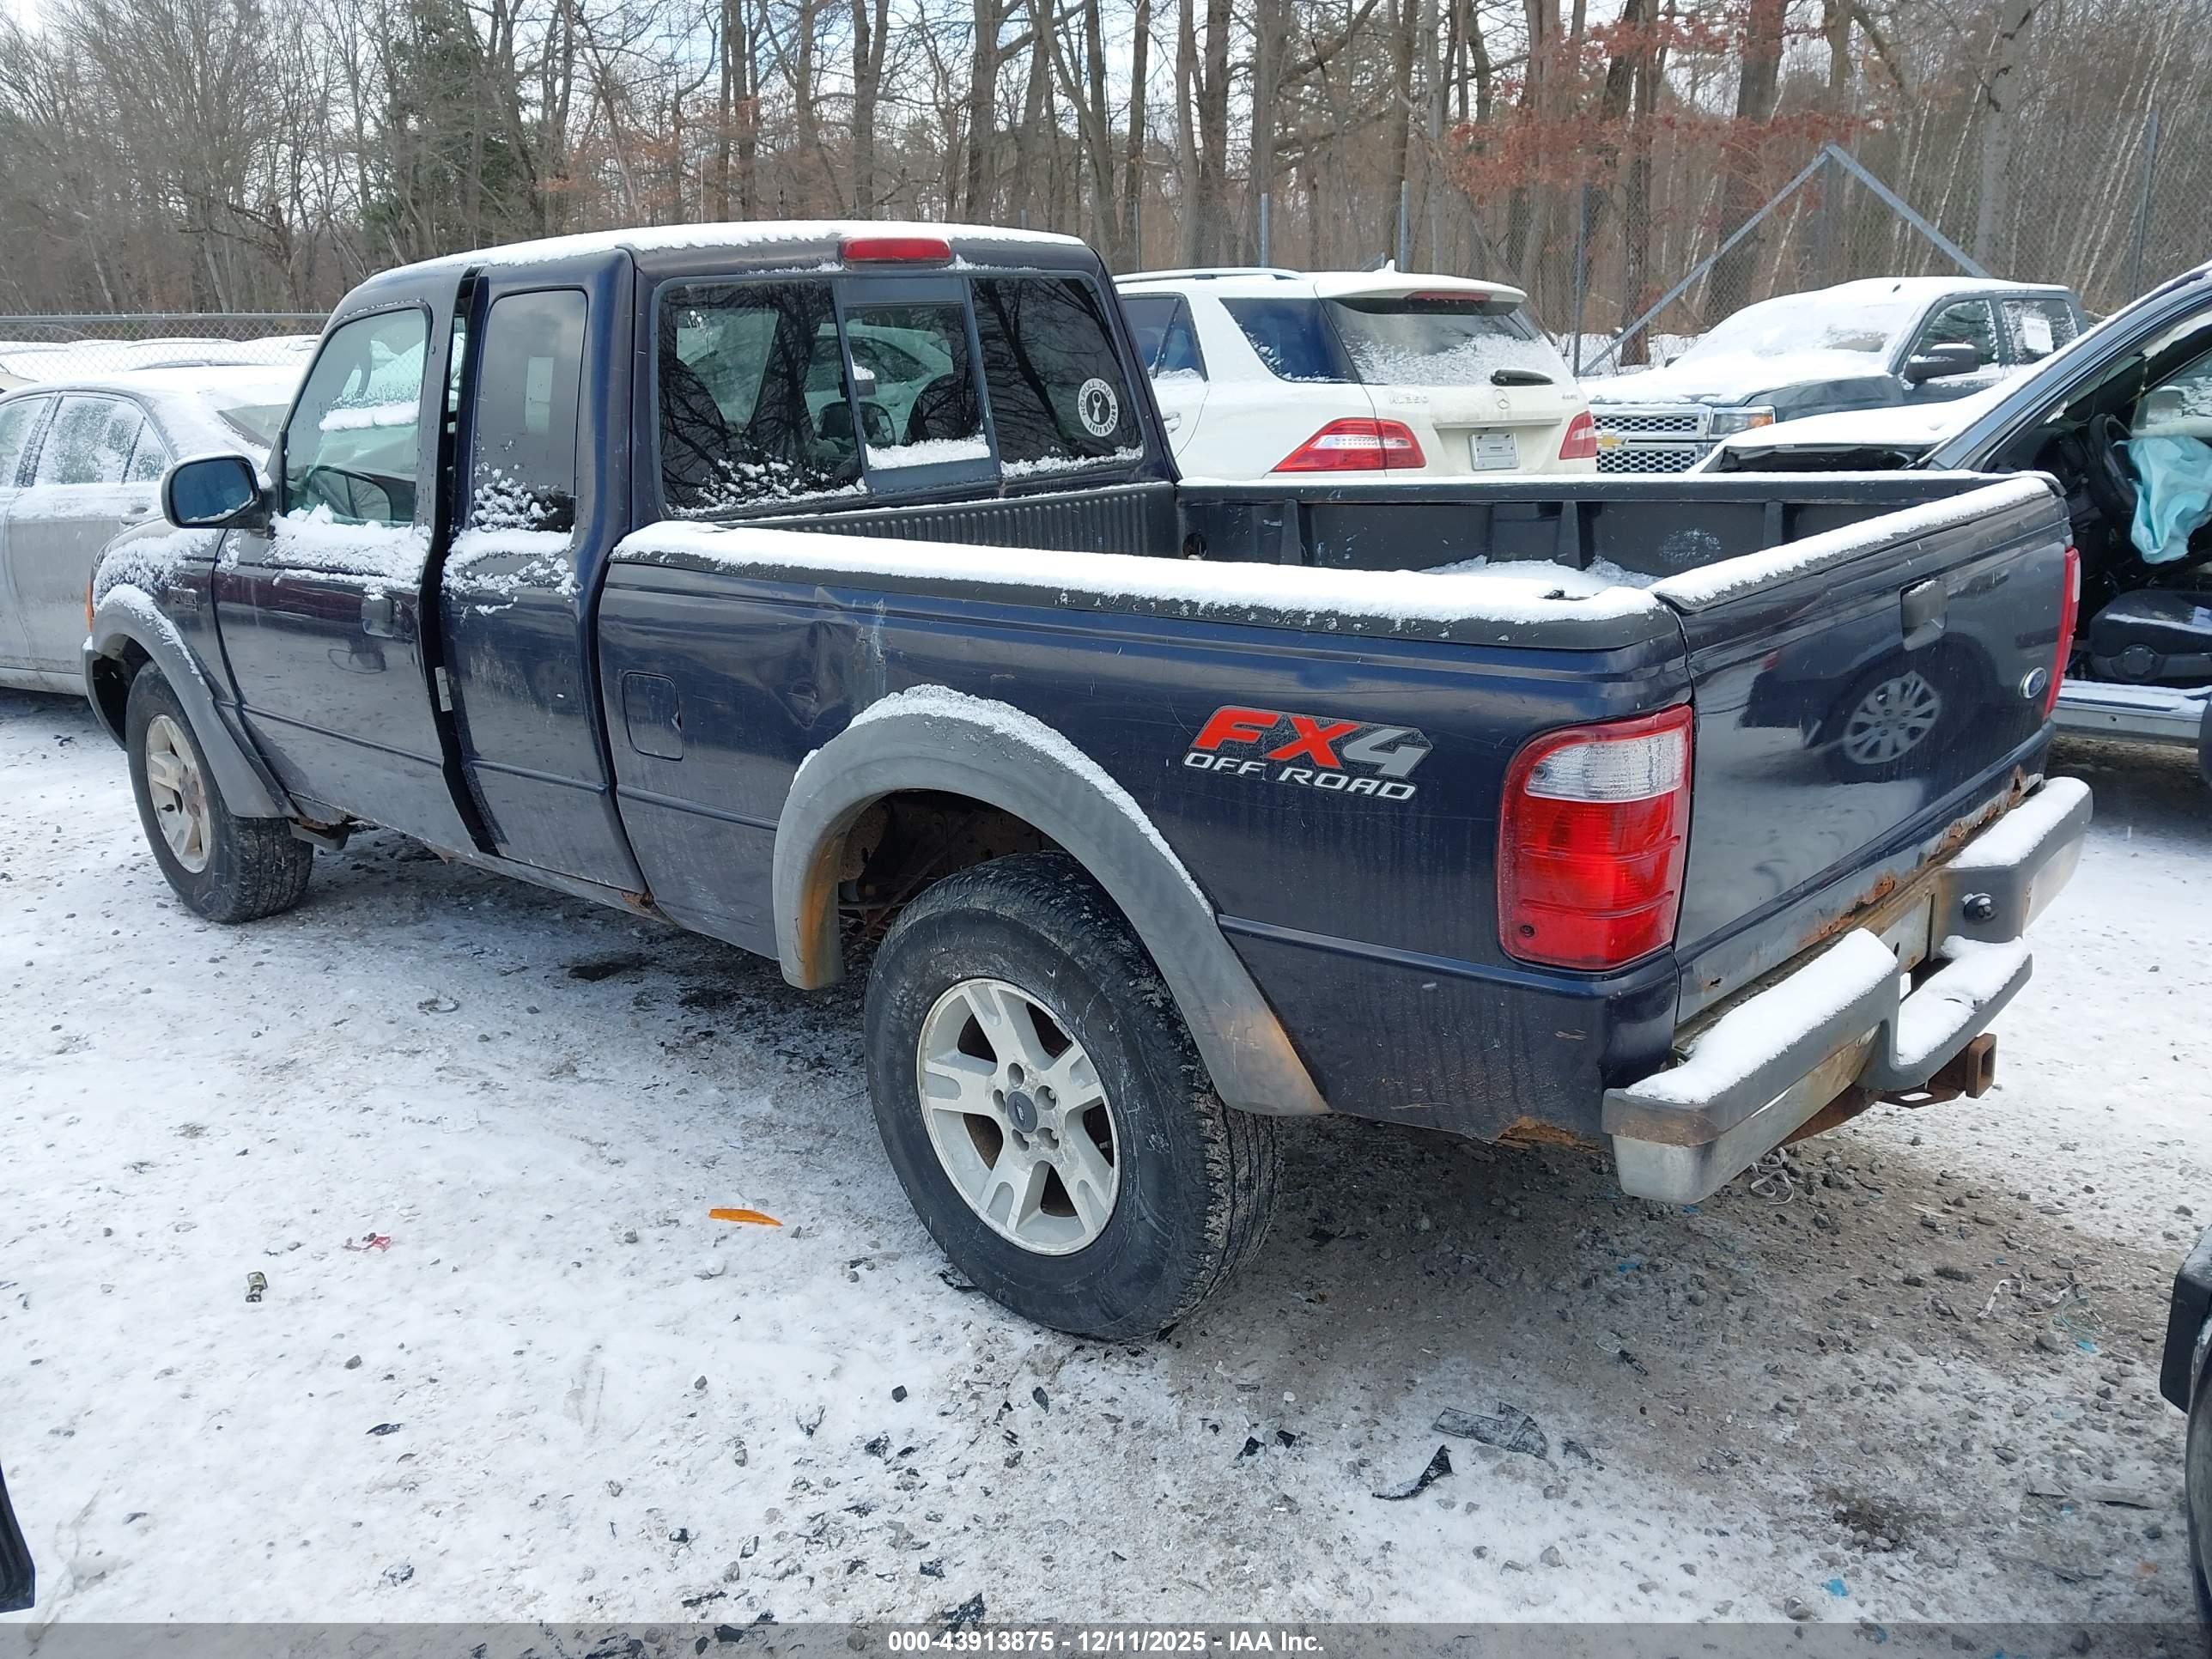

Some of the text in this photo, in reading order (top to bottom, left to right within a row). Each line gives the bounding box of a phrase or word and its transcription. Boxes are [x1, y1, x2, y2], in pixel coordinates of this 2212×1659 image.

[1081, 380, 1097, 398] PULL
[1079, 399, 1086, 416] NO
[1088, 422, 1103, 434] LEFT
[1191, 706, 1432, 777] FX4
[1183, 751, 1417, 801] OFF ROAD
